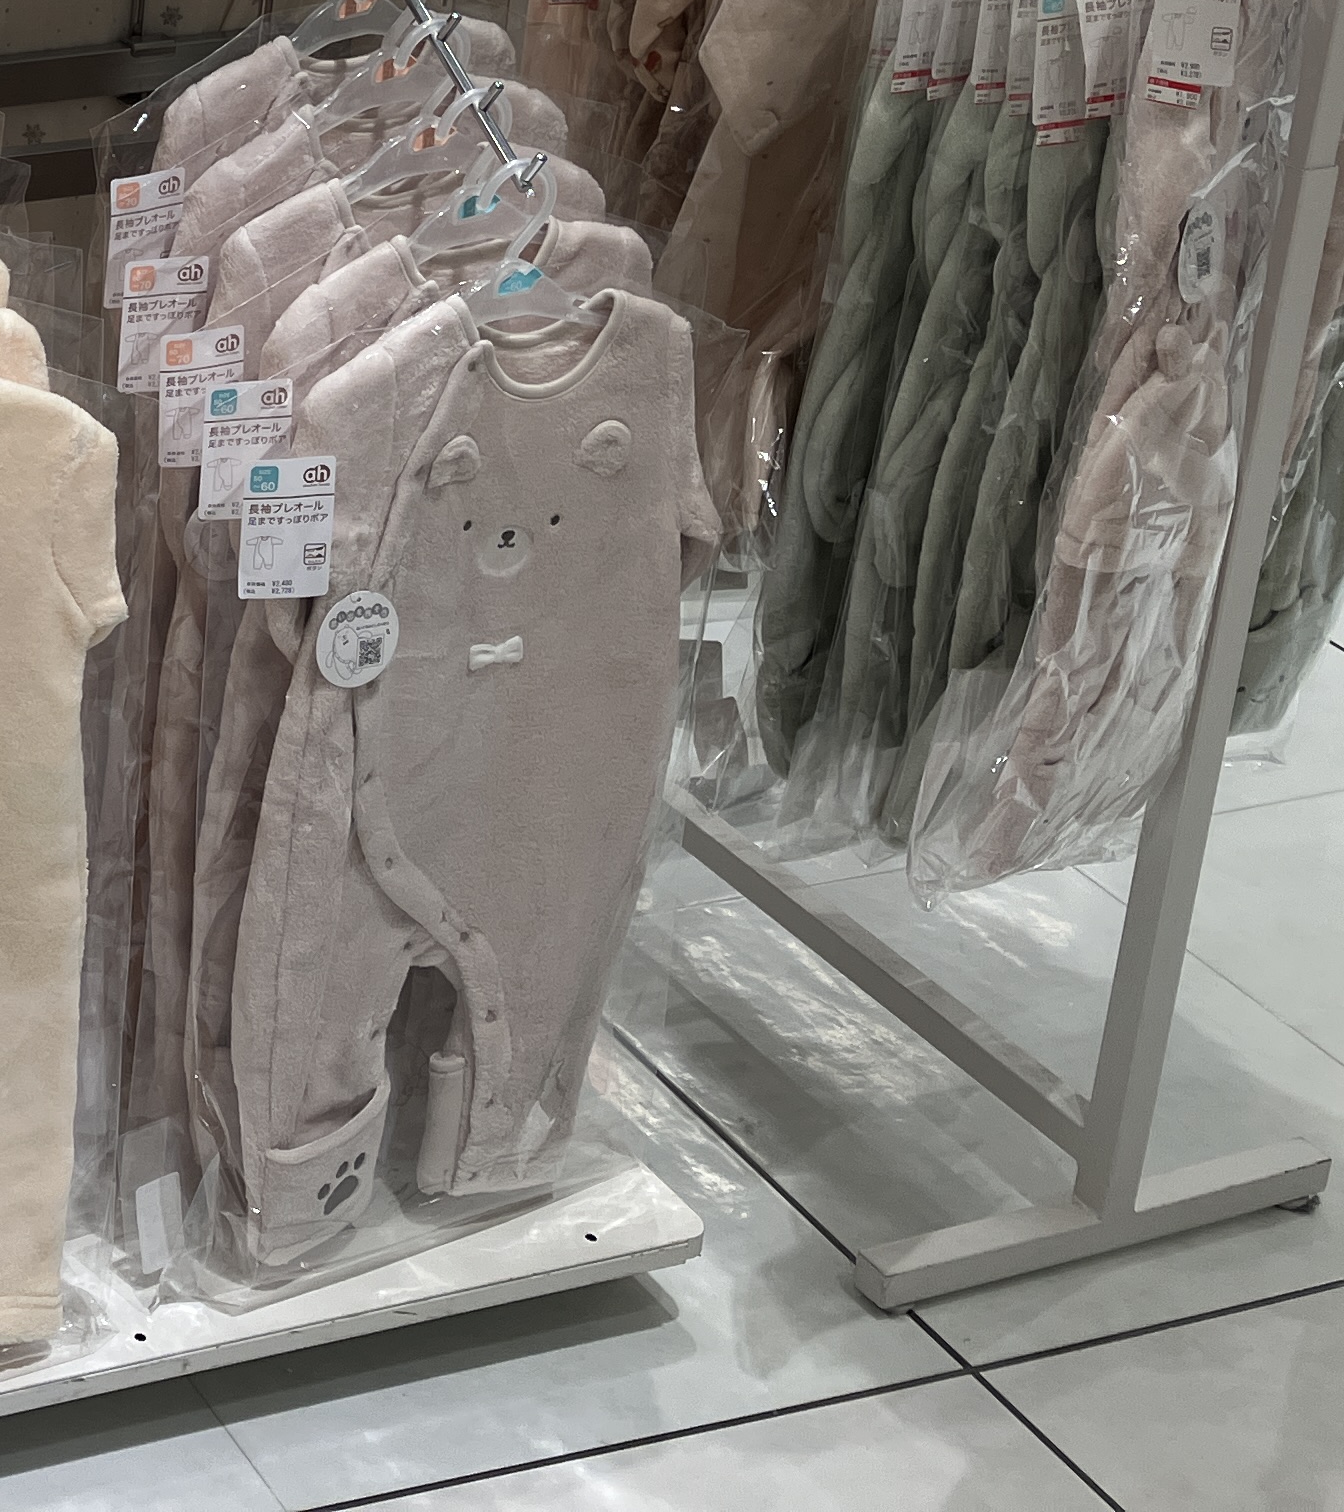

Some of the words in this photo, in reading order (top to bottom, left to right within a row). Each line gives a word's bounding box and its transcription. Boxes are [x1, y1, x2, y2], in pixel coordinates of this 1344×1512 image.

[158, 176, 180, 195] ah
[115, 209, 176, 230] 長袖プレオール
[177, 263, 204, 282] ah
[128, 298, 197, 313] 長袖プレオール
[215, 334, 240, 353] ah
[166, 369, 234, 388] 長袖プレオール
[261, 386, 288, 406] ah
[208, 422, 281, 438] 長袖プレオール
[302, 464, 331, 484] ah
[248, 500, 324, 515] 長袖プレオール
[247, 513, 329, 526] 足まですっぽりボア
